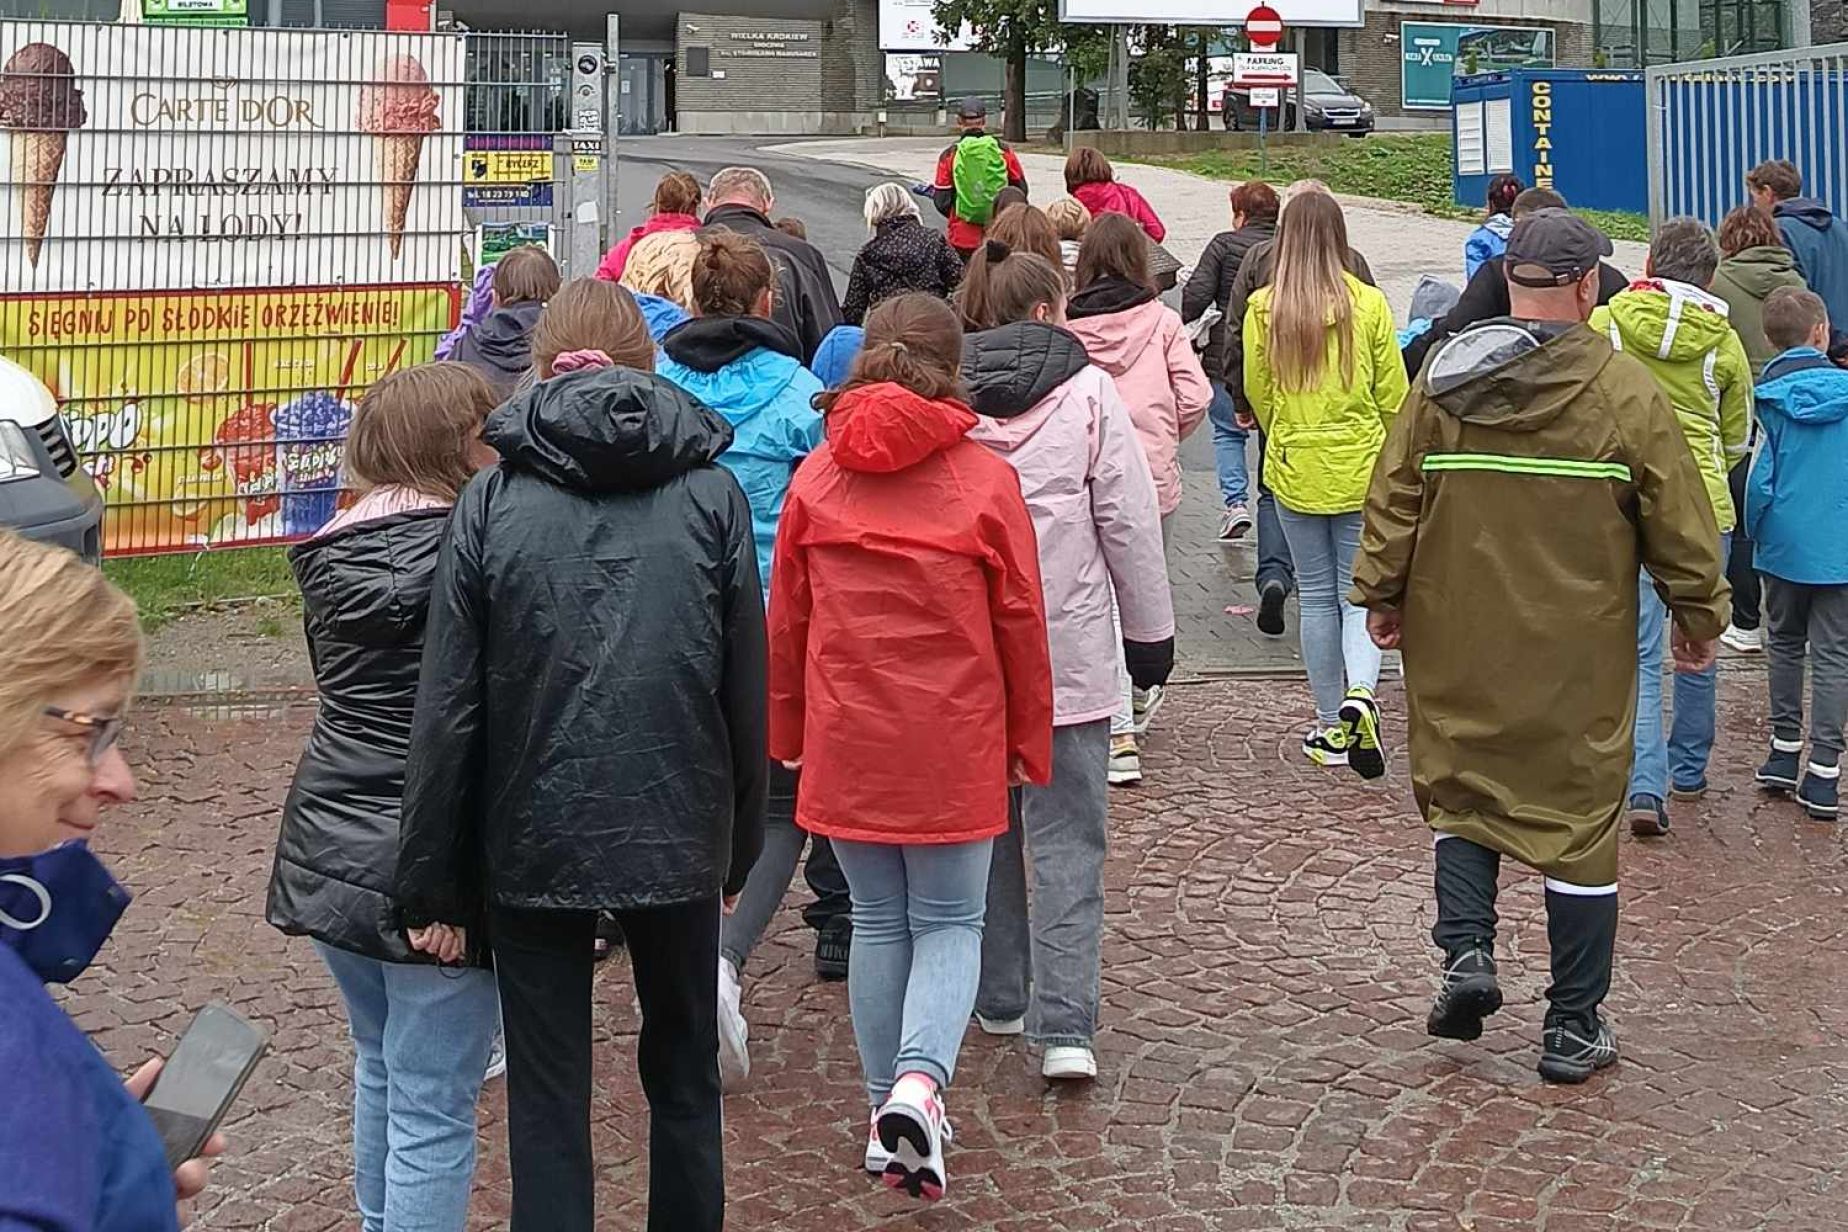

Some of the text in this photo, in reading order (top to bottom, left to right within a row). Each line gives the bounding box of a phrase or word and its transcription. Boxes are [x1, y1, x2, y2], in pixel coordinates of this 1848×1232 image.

[730, 32, 808, 41] WIELKA KROKIEW
[1247, 57, 1284, 65] PARKING
[131, 93, 230, 126] CARTE
[573, 141, 600, 150] TAXI
[1532, 81, 1554, 190] CONTAINE
[101, 167, 338, 197] ZAPRASZAMY
[138, 214, 187, 243] NA
